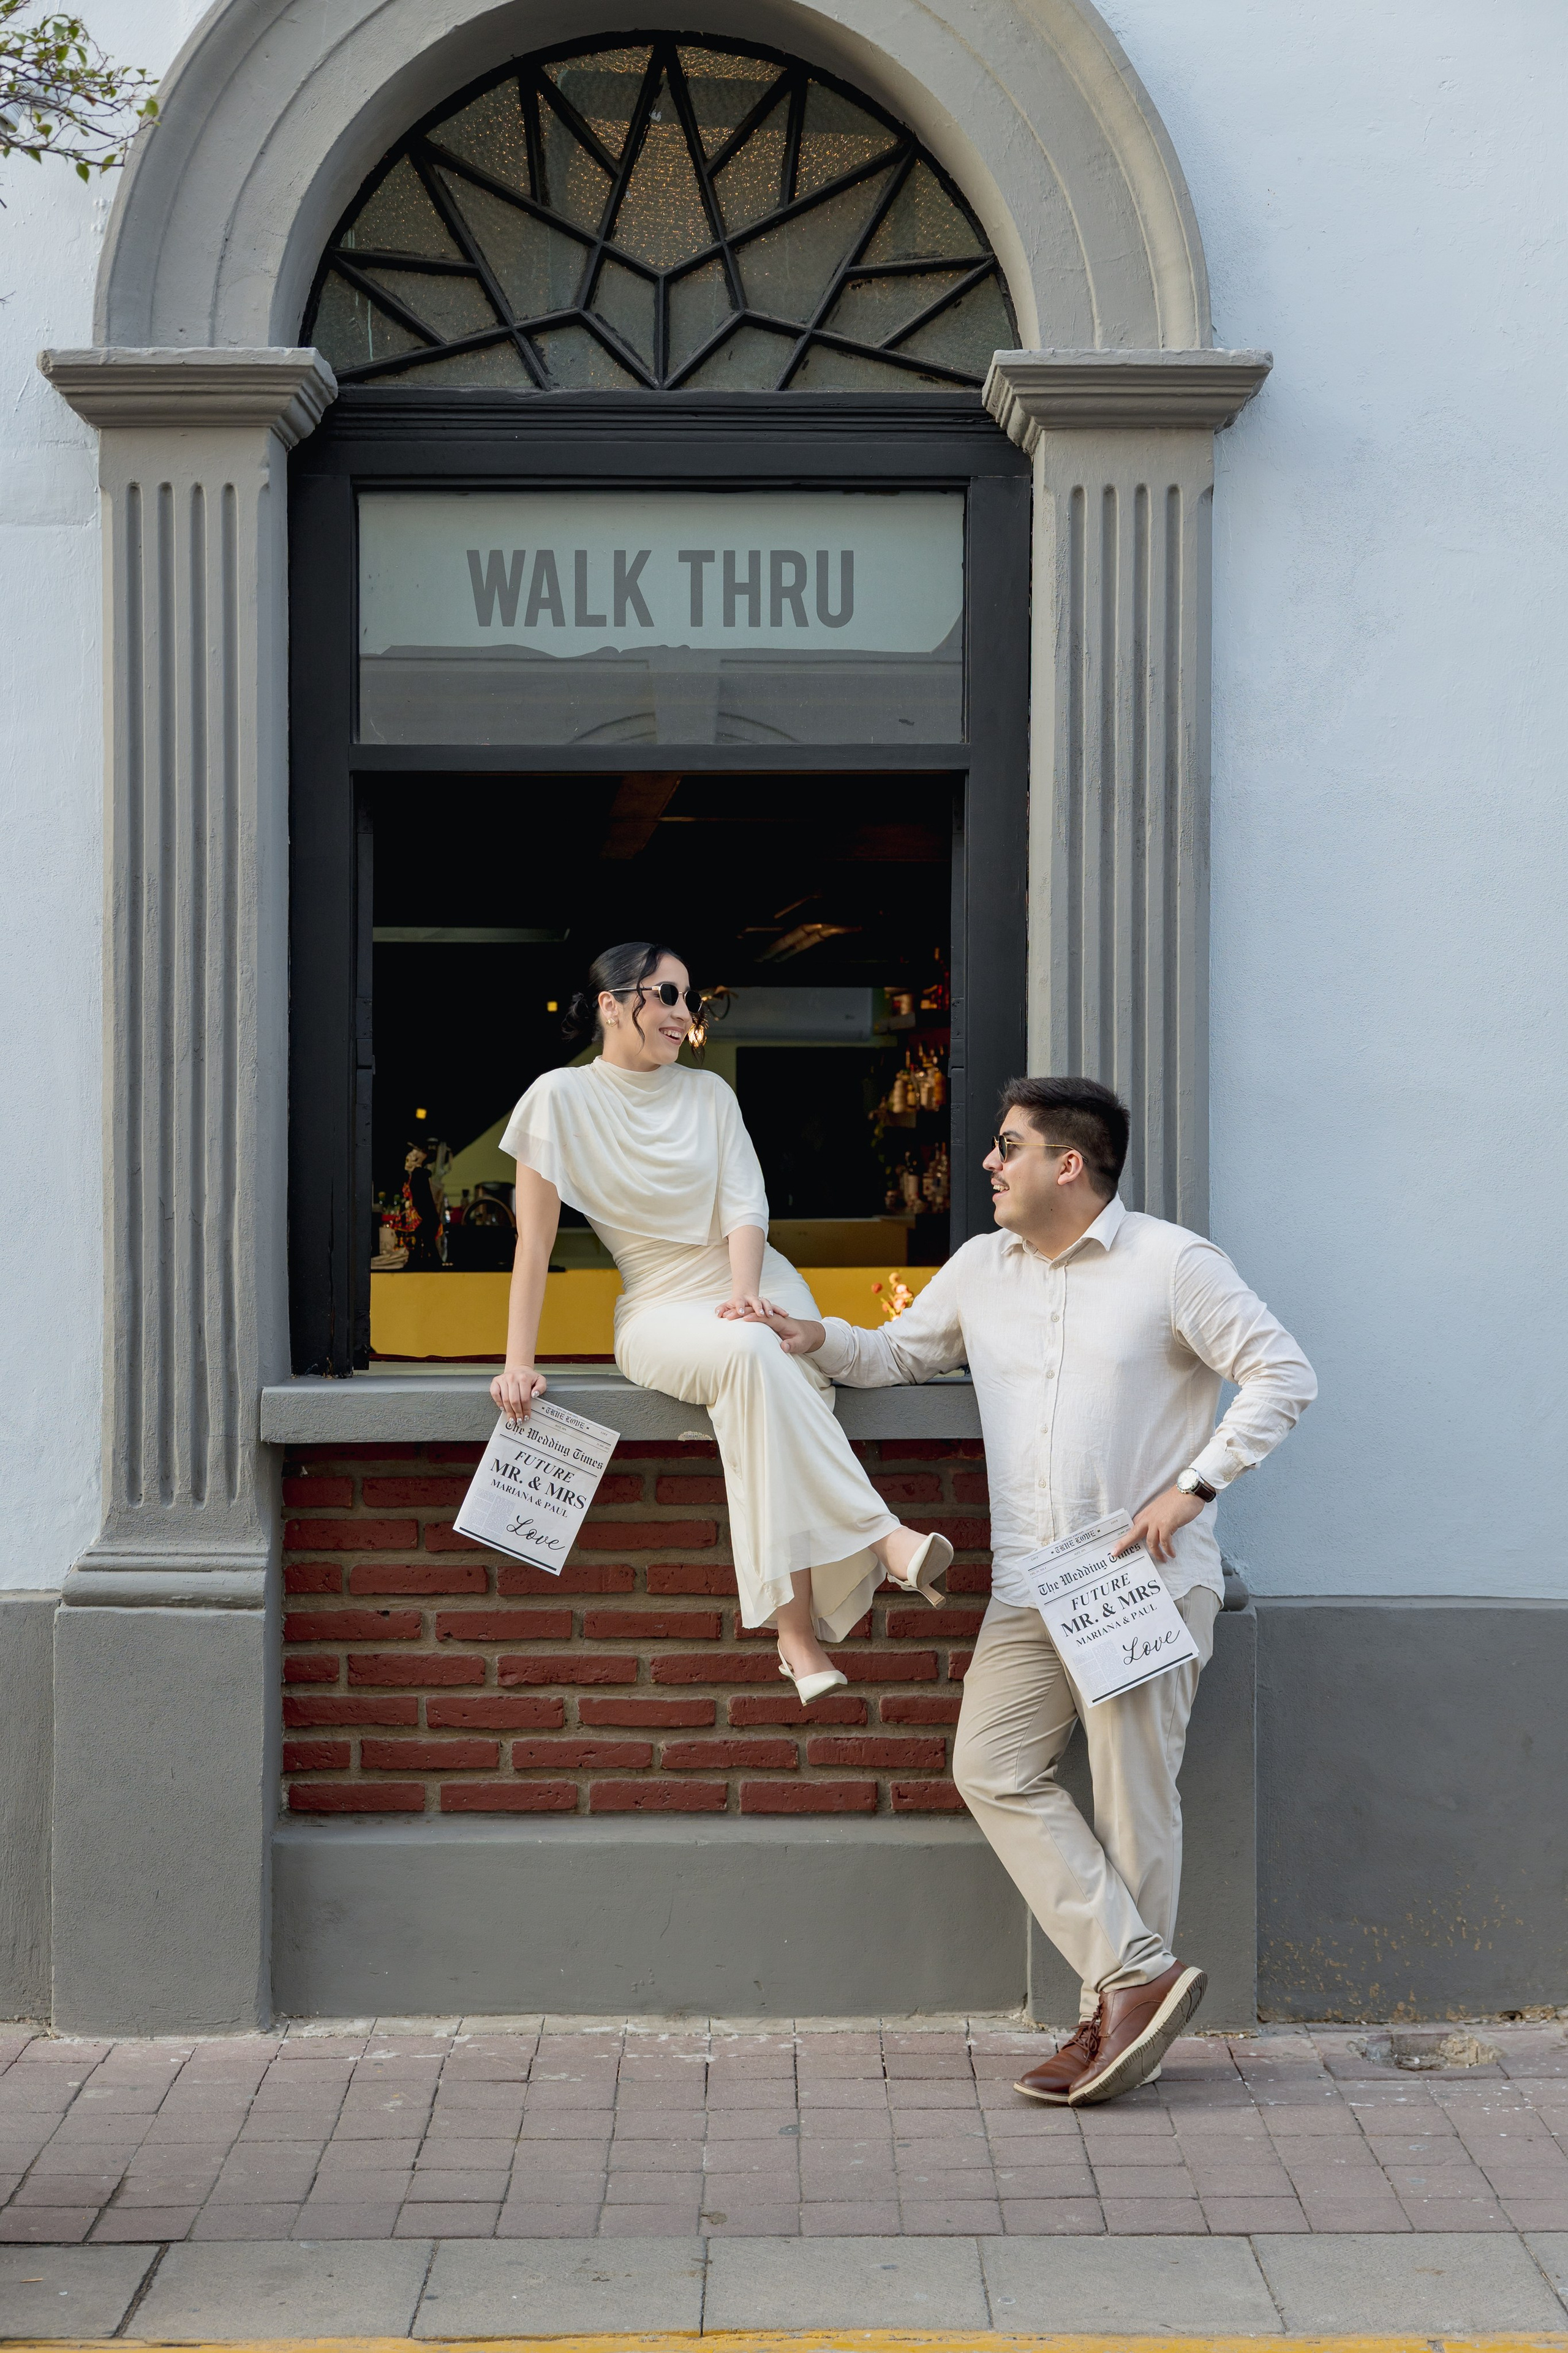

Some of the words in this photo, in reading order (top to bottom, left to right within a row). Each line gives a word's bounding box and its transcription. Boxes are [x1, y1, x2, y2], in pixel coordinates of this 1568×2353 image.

[466, 550, 655, 627] WALK
[678, 550, 854, 628] THRU
[514, 1451, 575, 1483] FUTURE
[527, 1428, 571, 1456] Wedding
[573, 1448, 603, 1470] Times
[490, 1459, 522, 1484] MR.
[529, 1476, 542, 1490] &
[545, 1482, 587, 1509] MRS
[491, 1479, 533, 1503] MARIANA
[544, 1503, 568, 1517] PAUL
[506, 1515, 565, 1550] Love
[1038, 1582, 1059, 1596] The
[1060, 1560, 1107, 1585] Wedding
[1072, 1573, 1131, 1611] FUTURE
[1060, 1612, 1098, 1637] MR.
[1102, 1603, 1116, 1617] &
[1117, 1579, 1161, 1611] MRS
[1076, 1622, 1121, 1647] MARIANA
[1131, 1604, 1157, 1622] PAUL
[1123, 1630, 1180, 1665] Love
